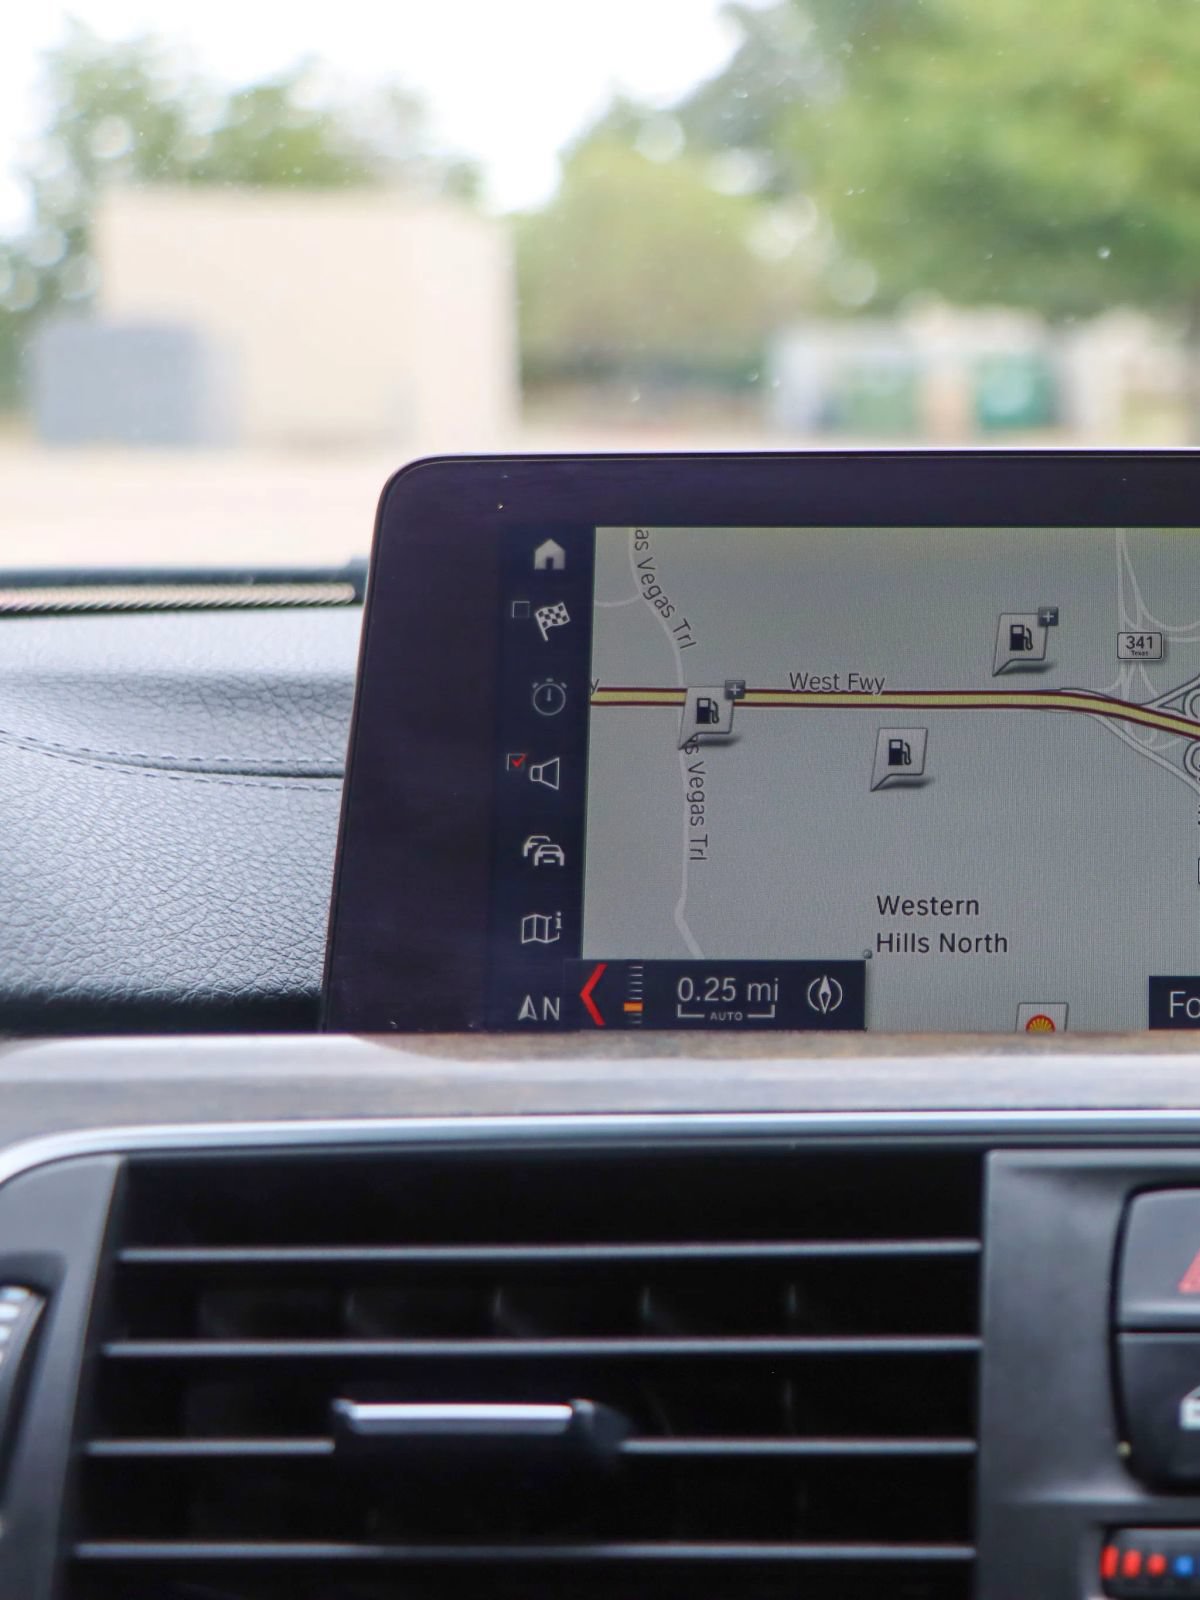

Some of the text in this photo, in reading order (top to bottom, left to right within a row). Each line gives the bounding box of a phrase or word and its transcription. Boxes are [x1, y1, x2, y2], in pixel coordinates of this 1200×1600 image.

[634, 528, 697, 650] as Vegas Trl
[1125, 635, 1153, 650] 341
[789, 671, 886, 695] West Fwy
[686, 760, 707, 827] Vegas
[689, 833, 709, 861] Trl
[876, 895, 980, 917] Western
[876, 933, 1009, 954] Hills North
[677, 977, 779, 1002] 0.25 mi
[543, 997, 561, 1020] N
[710, 1012, 744, 1021] AUTO
